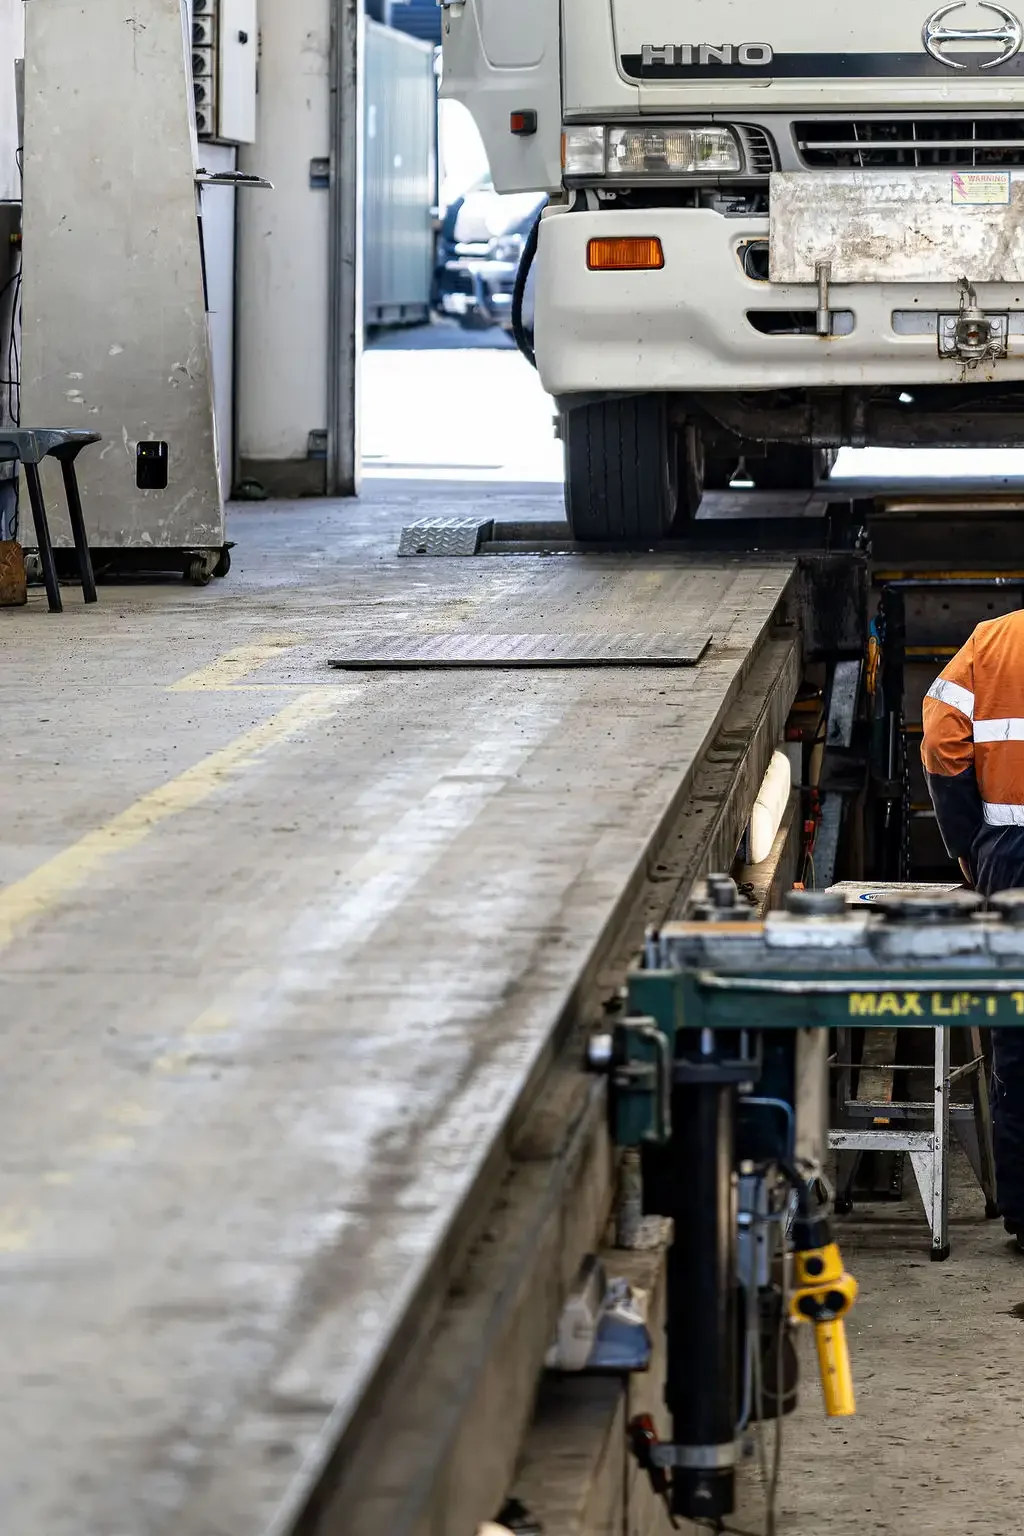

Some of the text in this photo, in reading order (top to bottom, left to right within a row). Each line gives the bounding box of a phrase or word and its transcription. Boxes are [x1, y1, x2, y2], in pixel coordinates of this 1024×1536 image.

[641, 43, 773, 66] HINO
[967, 175, 1008, 183] WARNING
[849, 991, 924, 1017] MAX
